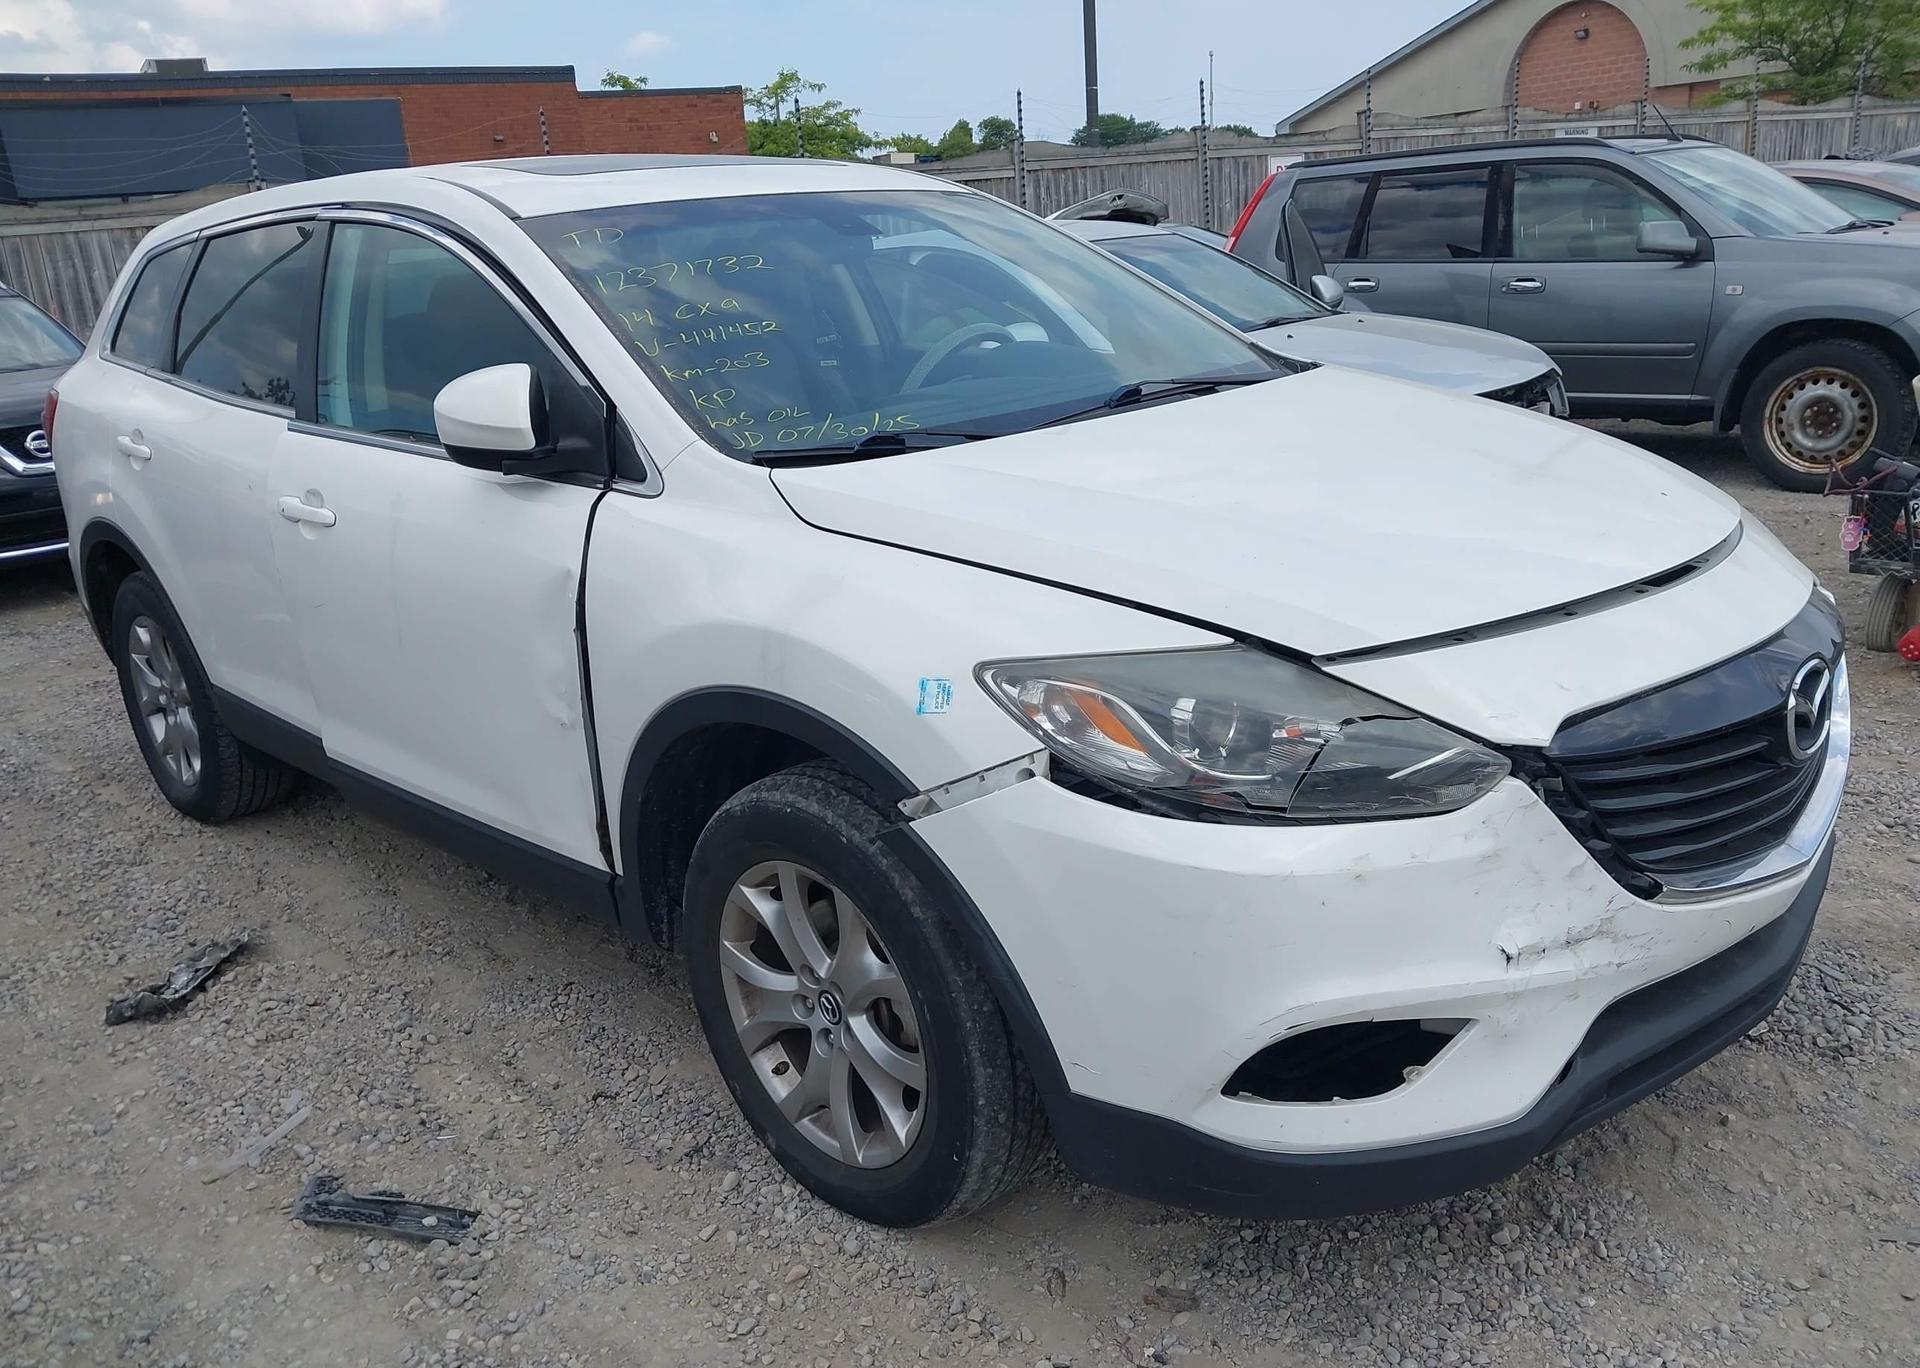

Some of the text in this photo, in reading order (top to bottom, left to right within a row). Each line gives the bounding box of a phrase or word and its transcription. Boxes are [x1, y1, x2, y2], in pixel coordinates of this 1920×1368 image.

[561, 227, 624, 249] TD
[594, 254, 775, 294] 12371732
[618, 308, 655, 332] 14
[732, 412, 921, 450] JD 07/30/25
